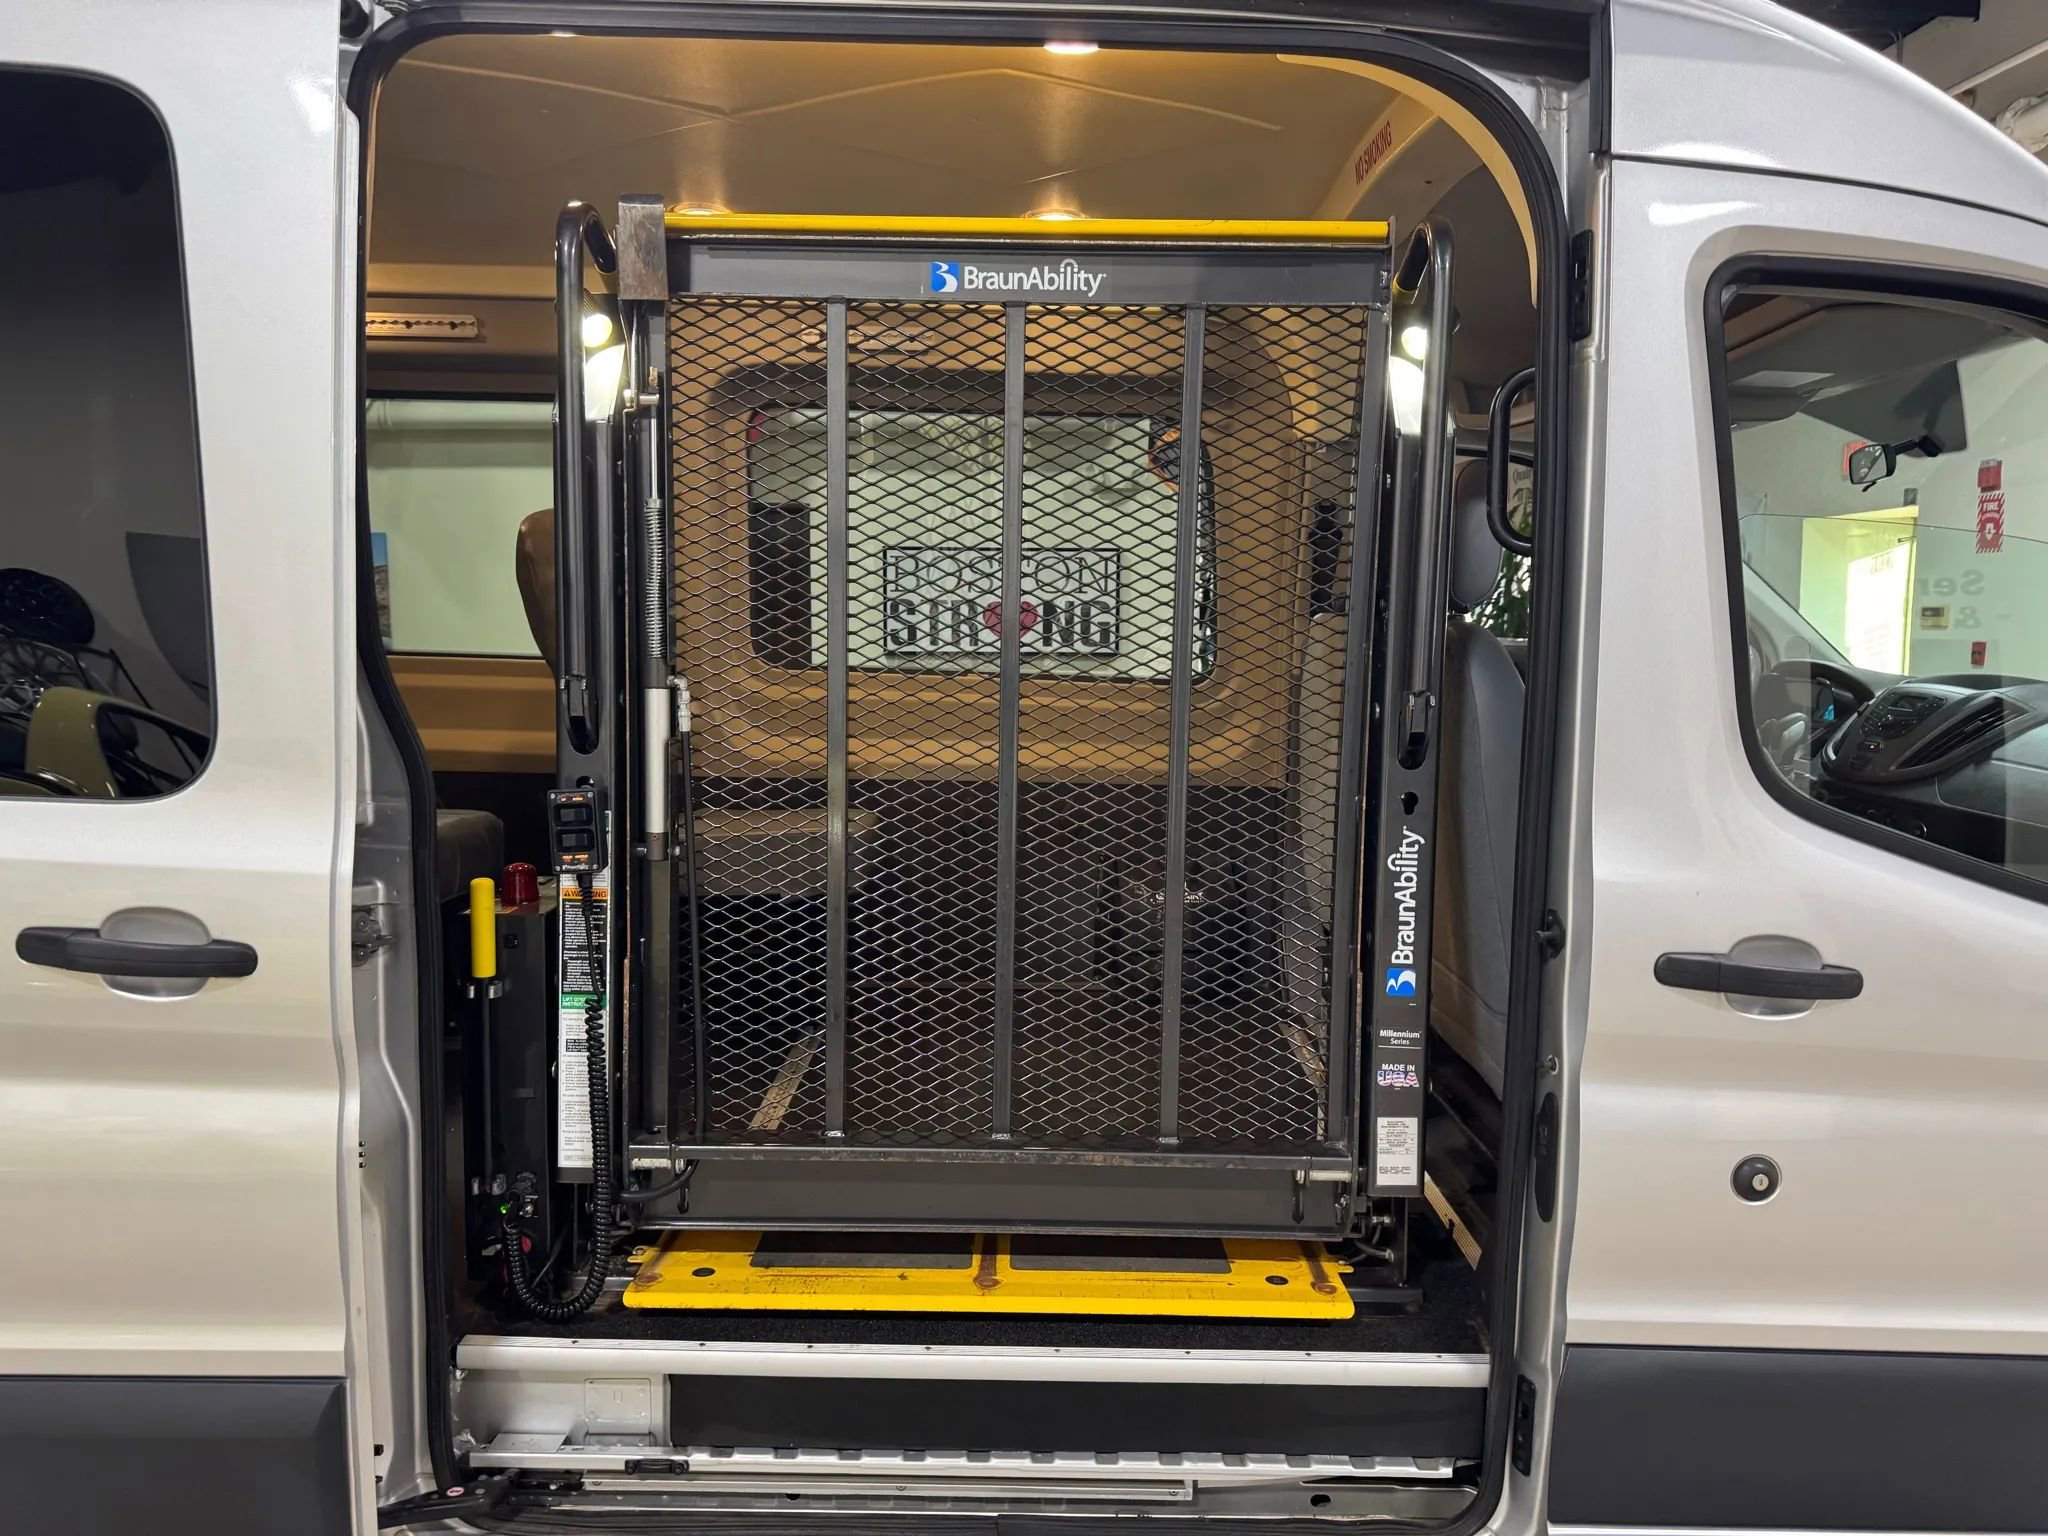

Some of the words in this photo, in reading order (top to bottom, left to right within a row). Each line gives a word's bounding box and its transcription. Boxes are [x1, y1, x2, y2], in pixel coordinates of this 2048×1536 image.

[1354, 155, 1364, 185] NO
[1363, 120, 1392, 175] SMOKING
[964, 258, 1104, 298] BraunAbility
[1983, 501, 1999, 511] FIRE
[890, 555, 1109, 593] BOSON
[570, 889, 607, 898] WAING
[1387, 827, 1426, 965] BraunAbility
[1380, 1029, 1420, 1039] Millennium
[1382, 1063, 1405, 1071] MADE
[1377, 1071, 1420, 1087] USA
